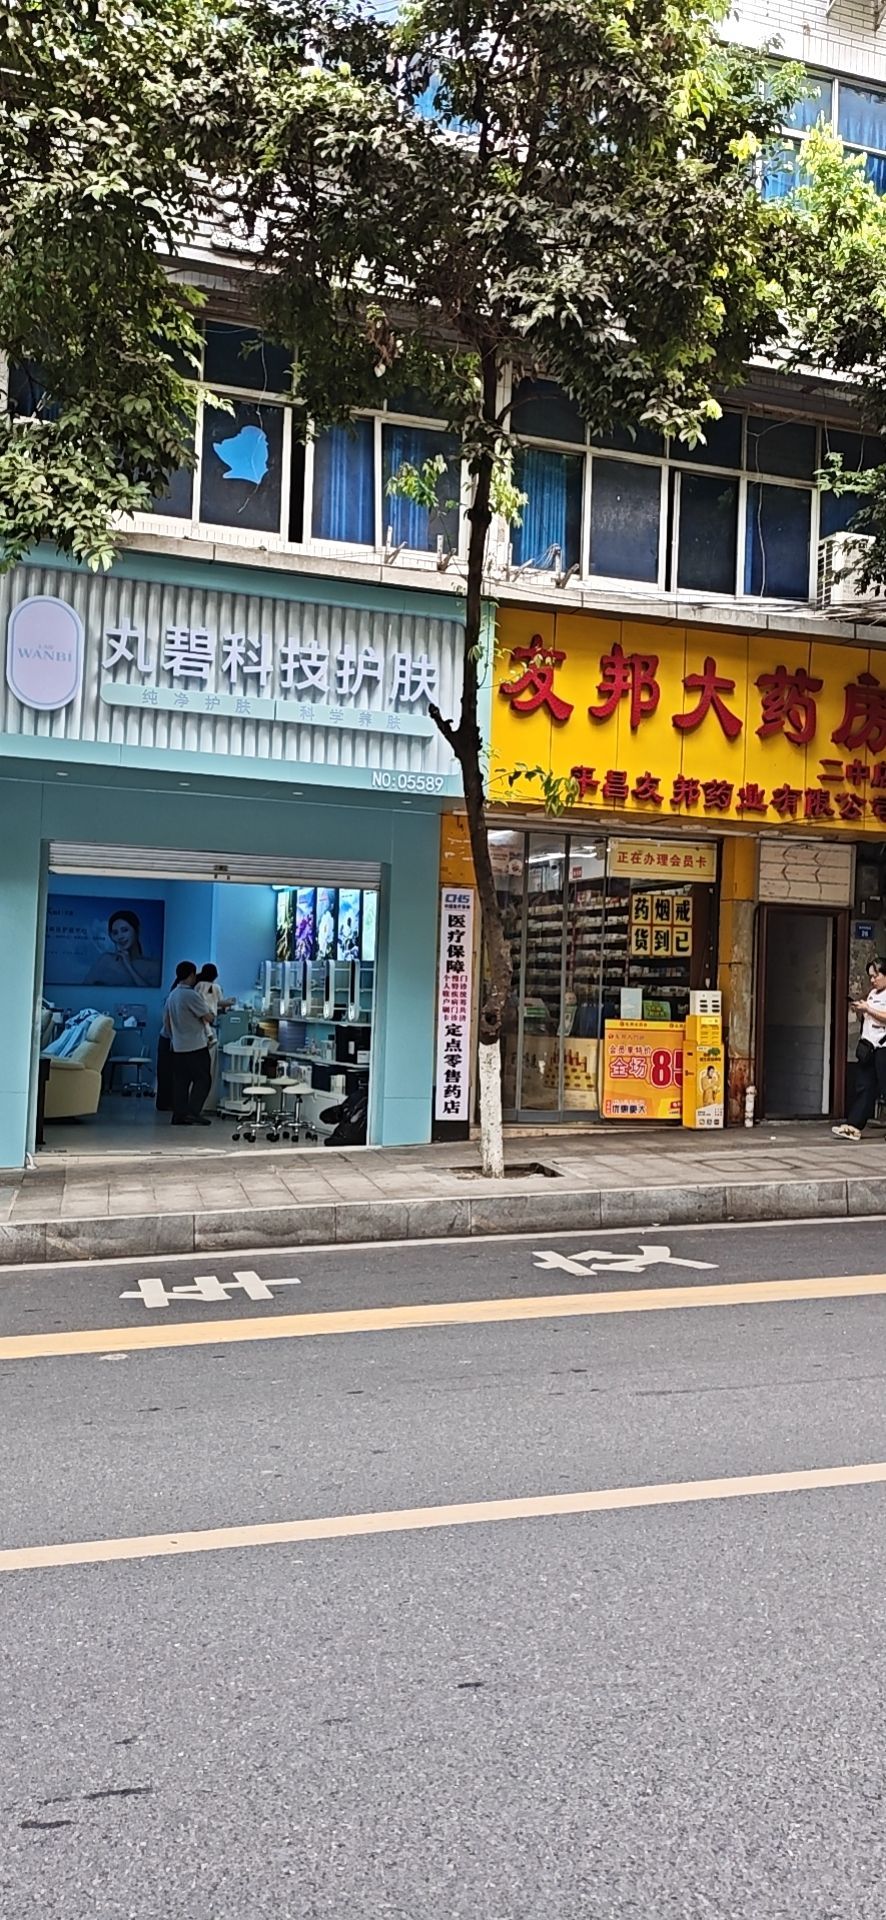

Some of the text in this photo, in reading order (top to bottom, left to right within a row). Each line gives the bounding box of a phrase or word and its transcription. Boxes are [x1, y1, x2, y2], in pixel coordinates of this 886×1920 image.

[17, 646, 72, 662] WANBI
[101, 616, 441, 706] 丸碧科技护肤
[141, 688, 401, 730] 纯净护肤 科学养肤
[499, 633, 886, 755] 友邦大药房
[371, 770, 444, 792] NO:05589
[616, 850, 708, 869] 正在办理会员卡
[446, 914, 467, 974] 医疗保障
[442, 1023, 463, 1115] 定点零售药店
[610, 1056, 647, 1079] 全场
